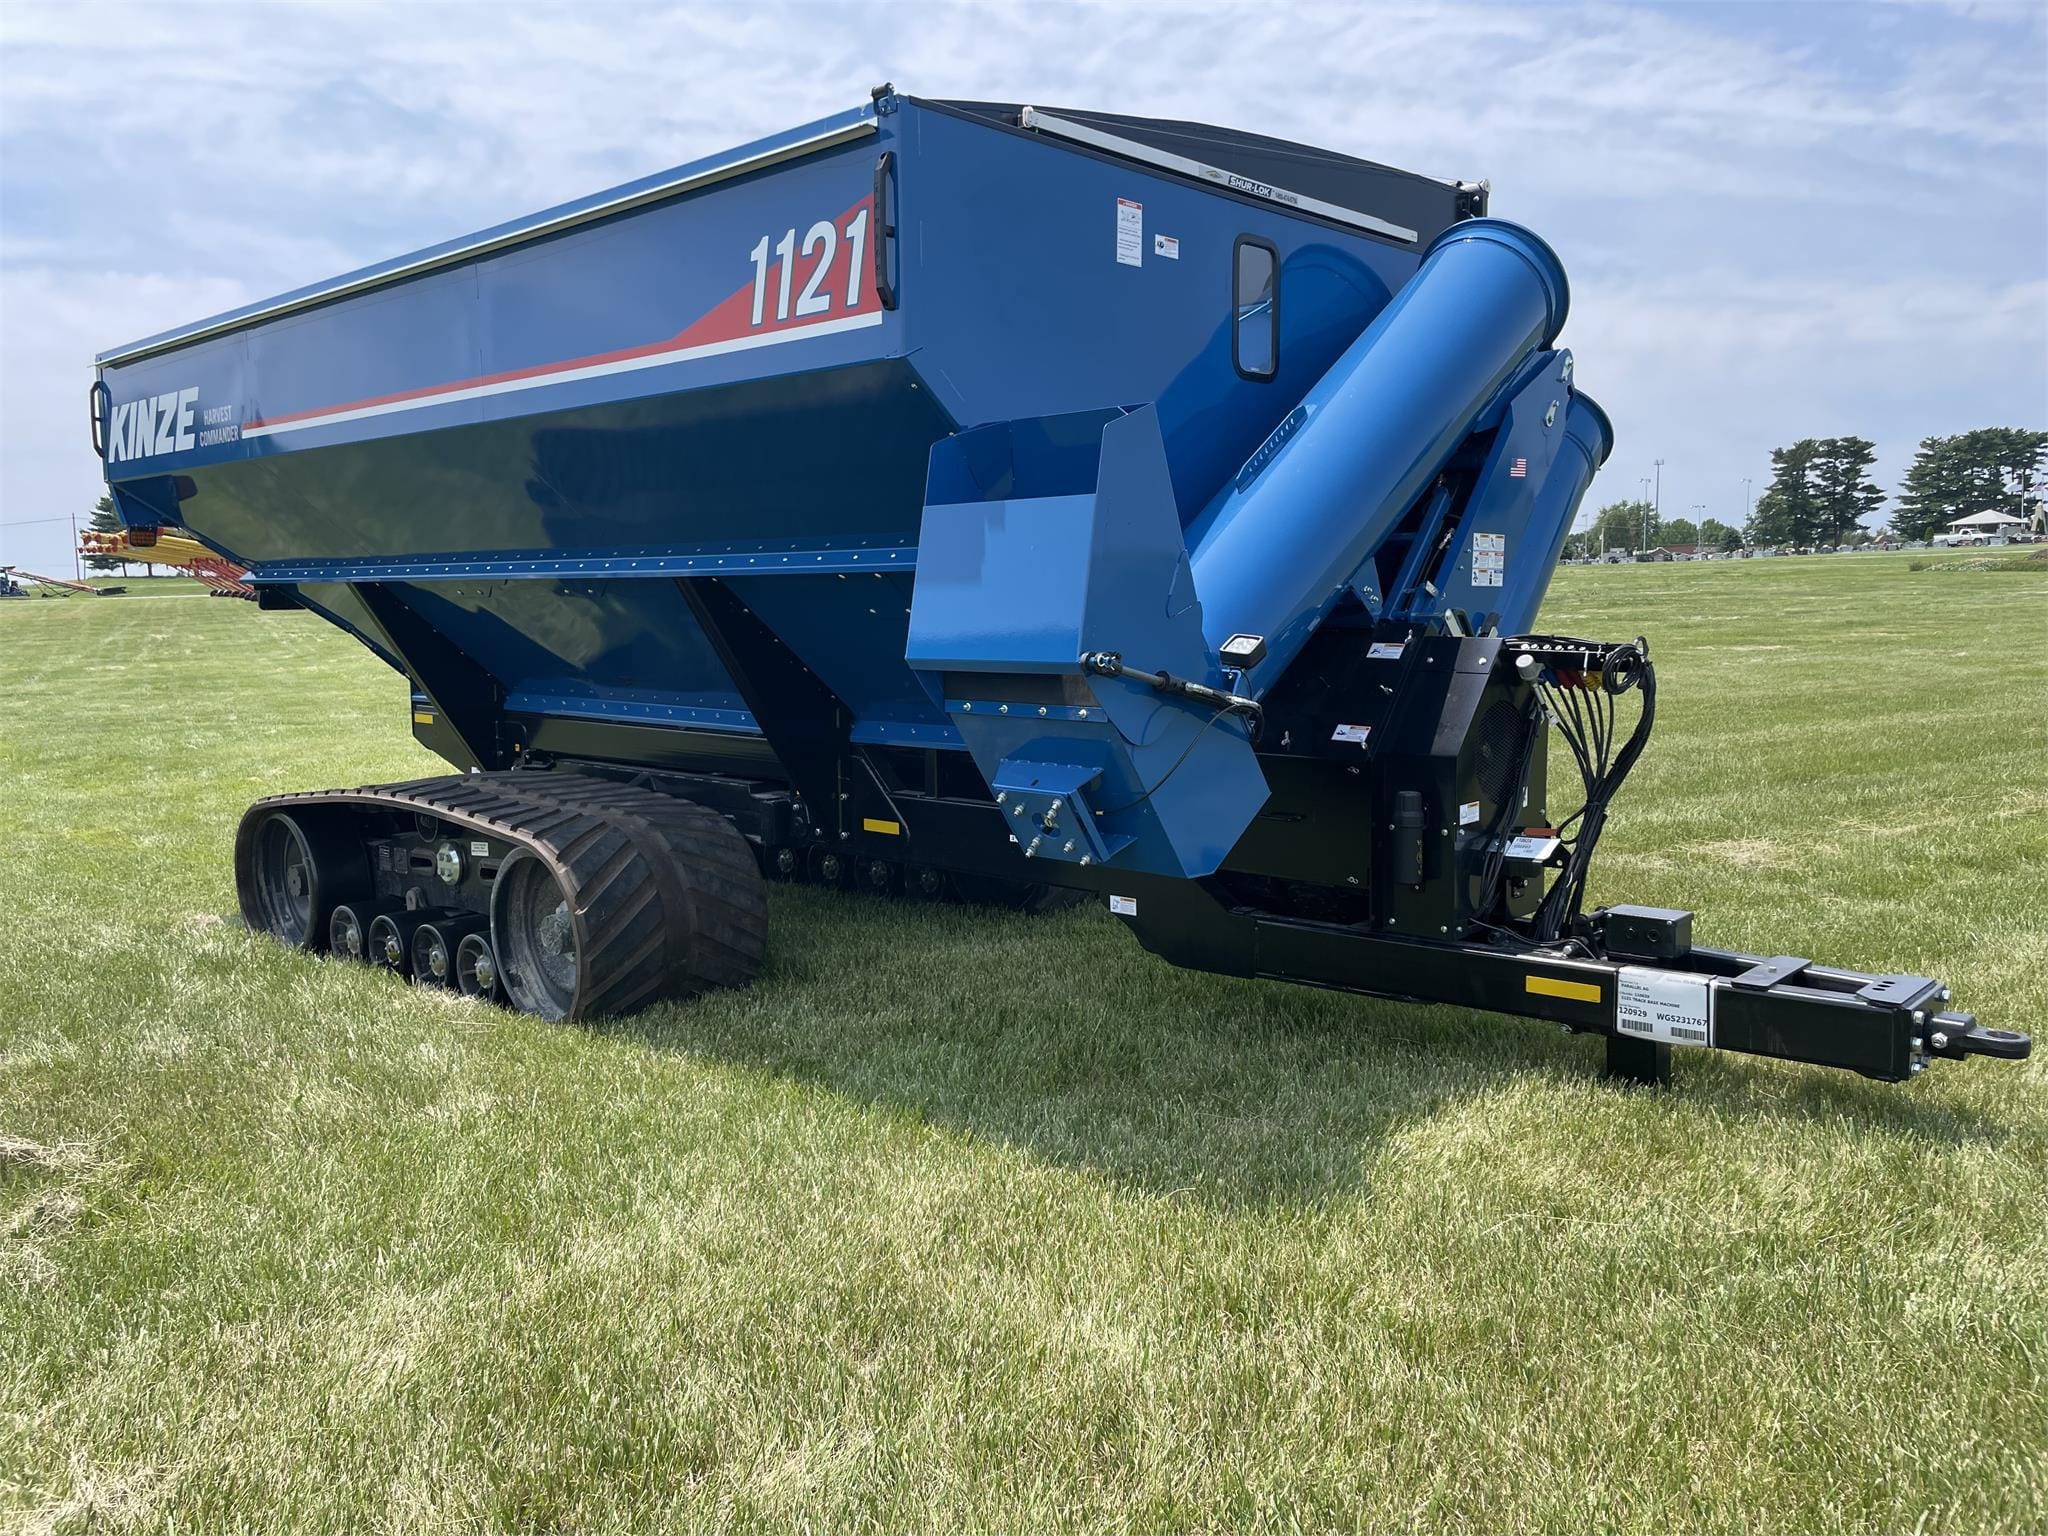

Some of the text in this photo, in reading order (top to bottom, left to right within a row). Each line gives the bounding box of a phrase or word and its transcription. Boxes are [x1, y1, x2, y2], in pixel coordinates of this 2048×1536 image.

[750, 209, 867, 325] 1121
[108, 386, 200, 464] KINZE
[203, 405, 232, 425] HARVEST
[200, 424, 239, 447] COMMANDER
[1618, 1006, 1707, 1027] 120929 WGS231767
